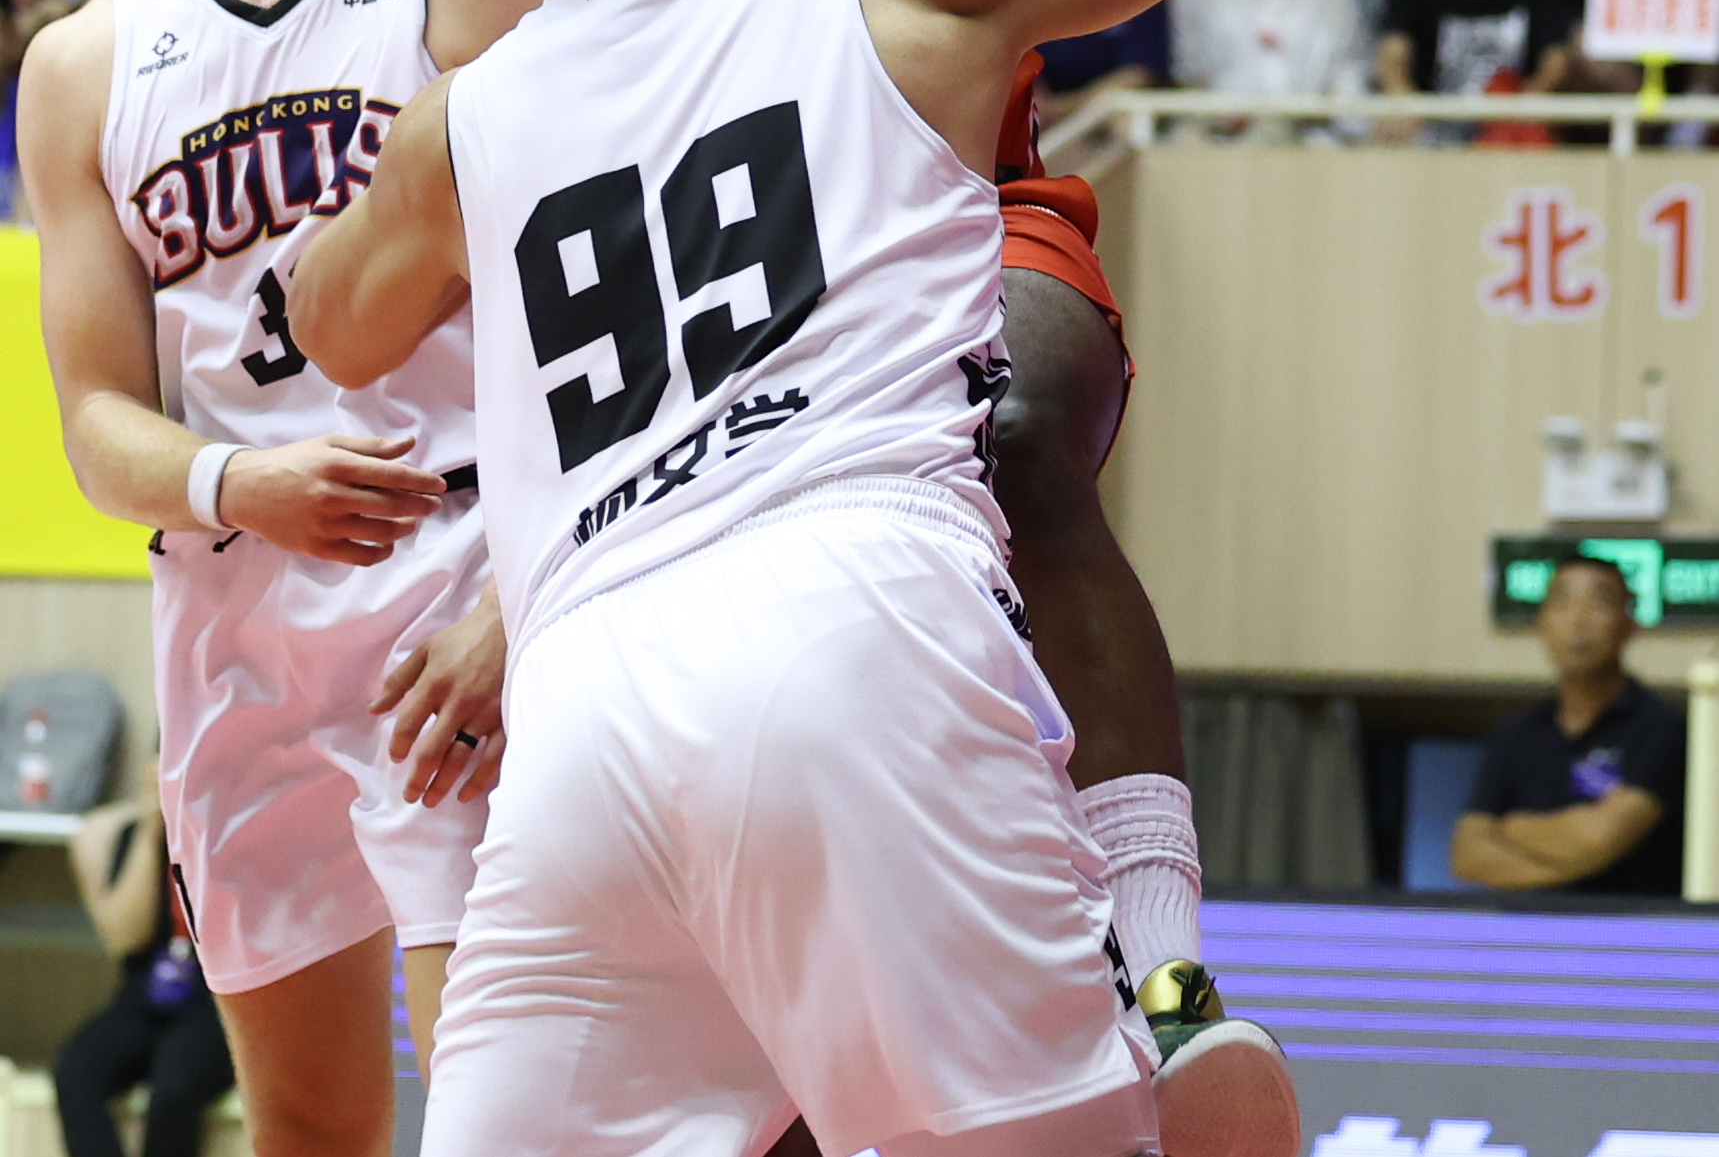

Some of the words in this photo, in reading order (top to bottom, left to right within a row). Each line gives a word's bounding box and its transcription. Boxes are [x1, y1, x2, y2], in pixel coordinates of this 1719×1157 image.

[271, 94, 354, 120] KONG
[138, 100, 401, 287] BULLS
[1492, 200, 1595, 308] 北
[1650, 195, 1691, 305] 1
[514, 99, 828, 475] 99
